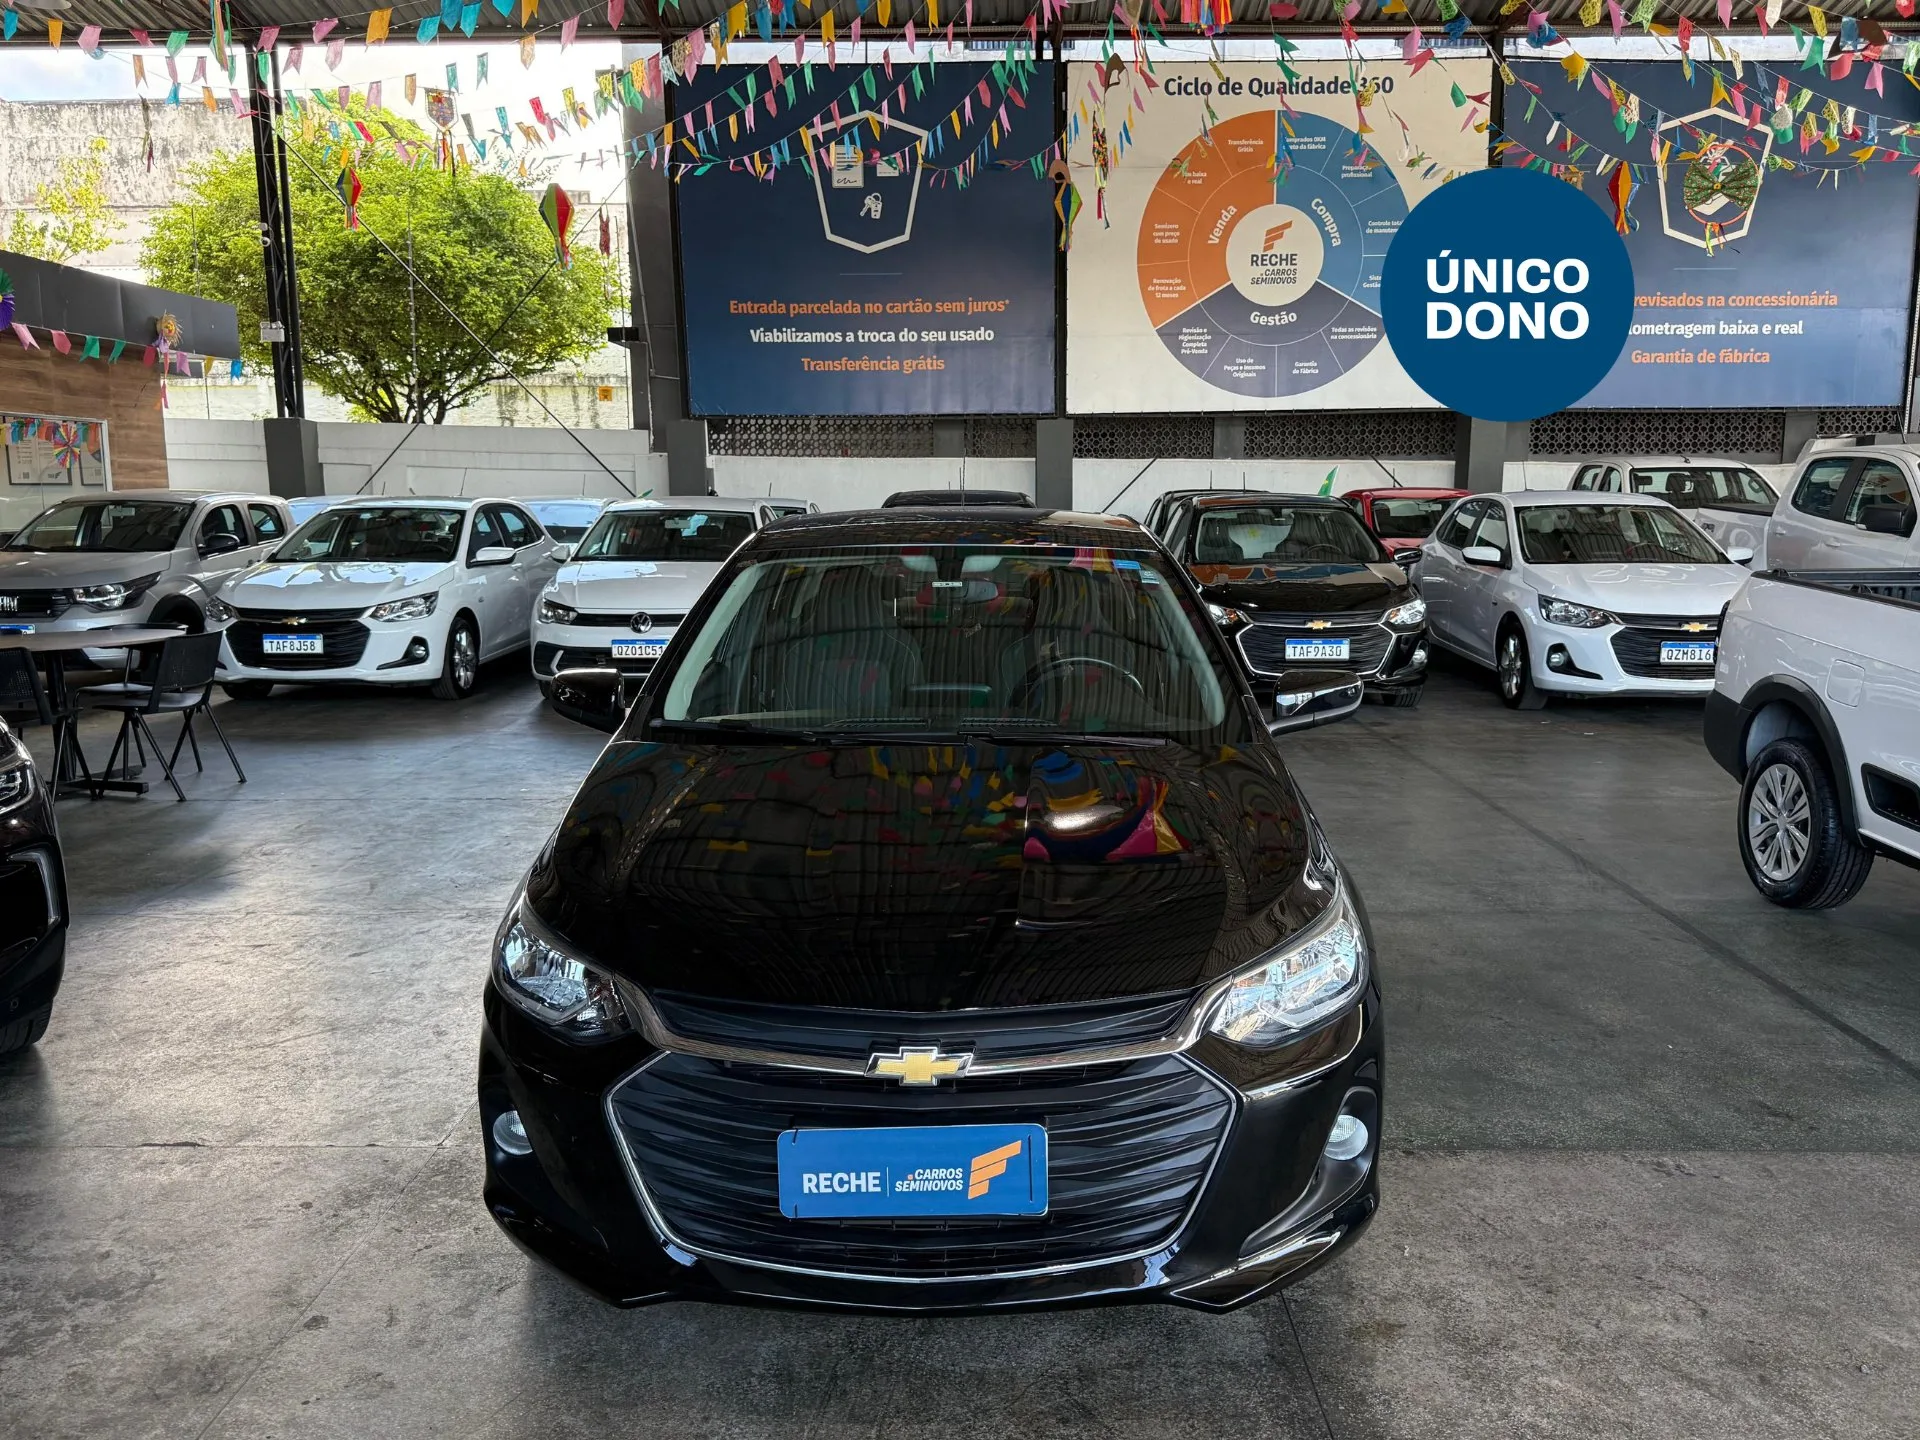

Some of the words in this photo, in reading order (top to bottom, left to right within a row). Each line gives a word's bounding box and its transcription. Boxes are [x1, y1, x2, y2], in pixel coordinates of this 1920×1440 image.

[1163, 76, 1213, 96] Ciclo
[1217, 77, 1244, 96] de
[1248, 76, 1351, 99] Qualidade
[1207, 205, 1238, 244] Venda
[1311, 198, 1341, 247] Compra
[1250, 253, 1298, 267] RECHE
[1250, 276, 1297, 285] SEMINOVOS
[1634, 292, 1704, 307] revisados
[1707, 295, 1725, 306] na
[1728, 291, 1838, 307] concessionária
[729, 300, 787, 315] Entrada
[789, 300, 861, 318] parcelada
[864, 302, 883, 314] no
[886, 298, 932, 314] cartão
[935, 299, 966, 313] sem
[1250, 311, 1297, 325] Gestão
[750, 328, 843, 343] Viabilizamos
[845, 331, 855, 342] a
[857, 329, 896, 343] troca
[899, 328, 918, 342] do
[920, 329, 947, 342] seu
[950, 327, 995, 341] usado
[1719, 319, 1759, 335] baixa
[1761, 323, 1772, 335] e
[1774, 320, 1804, 335] real
[1631, 348, 1694, 364] Garantia
[1697, 348, 1716, 363] de
[1719, 348, 1770, 363] fábrica
[801, 356, 900, 372] Transferência
[903, 355, 945, 374] grátis
[268, 640, 316, 652] TAF8J58
[1666, 649, 1711, 661] QZM8I6
[802, 1171, 882, 1195] RECHE
[895, 1179, 964, 1193] SEMINOVOS
